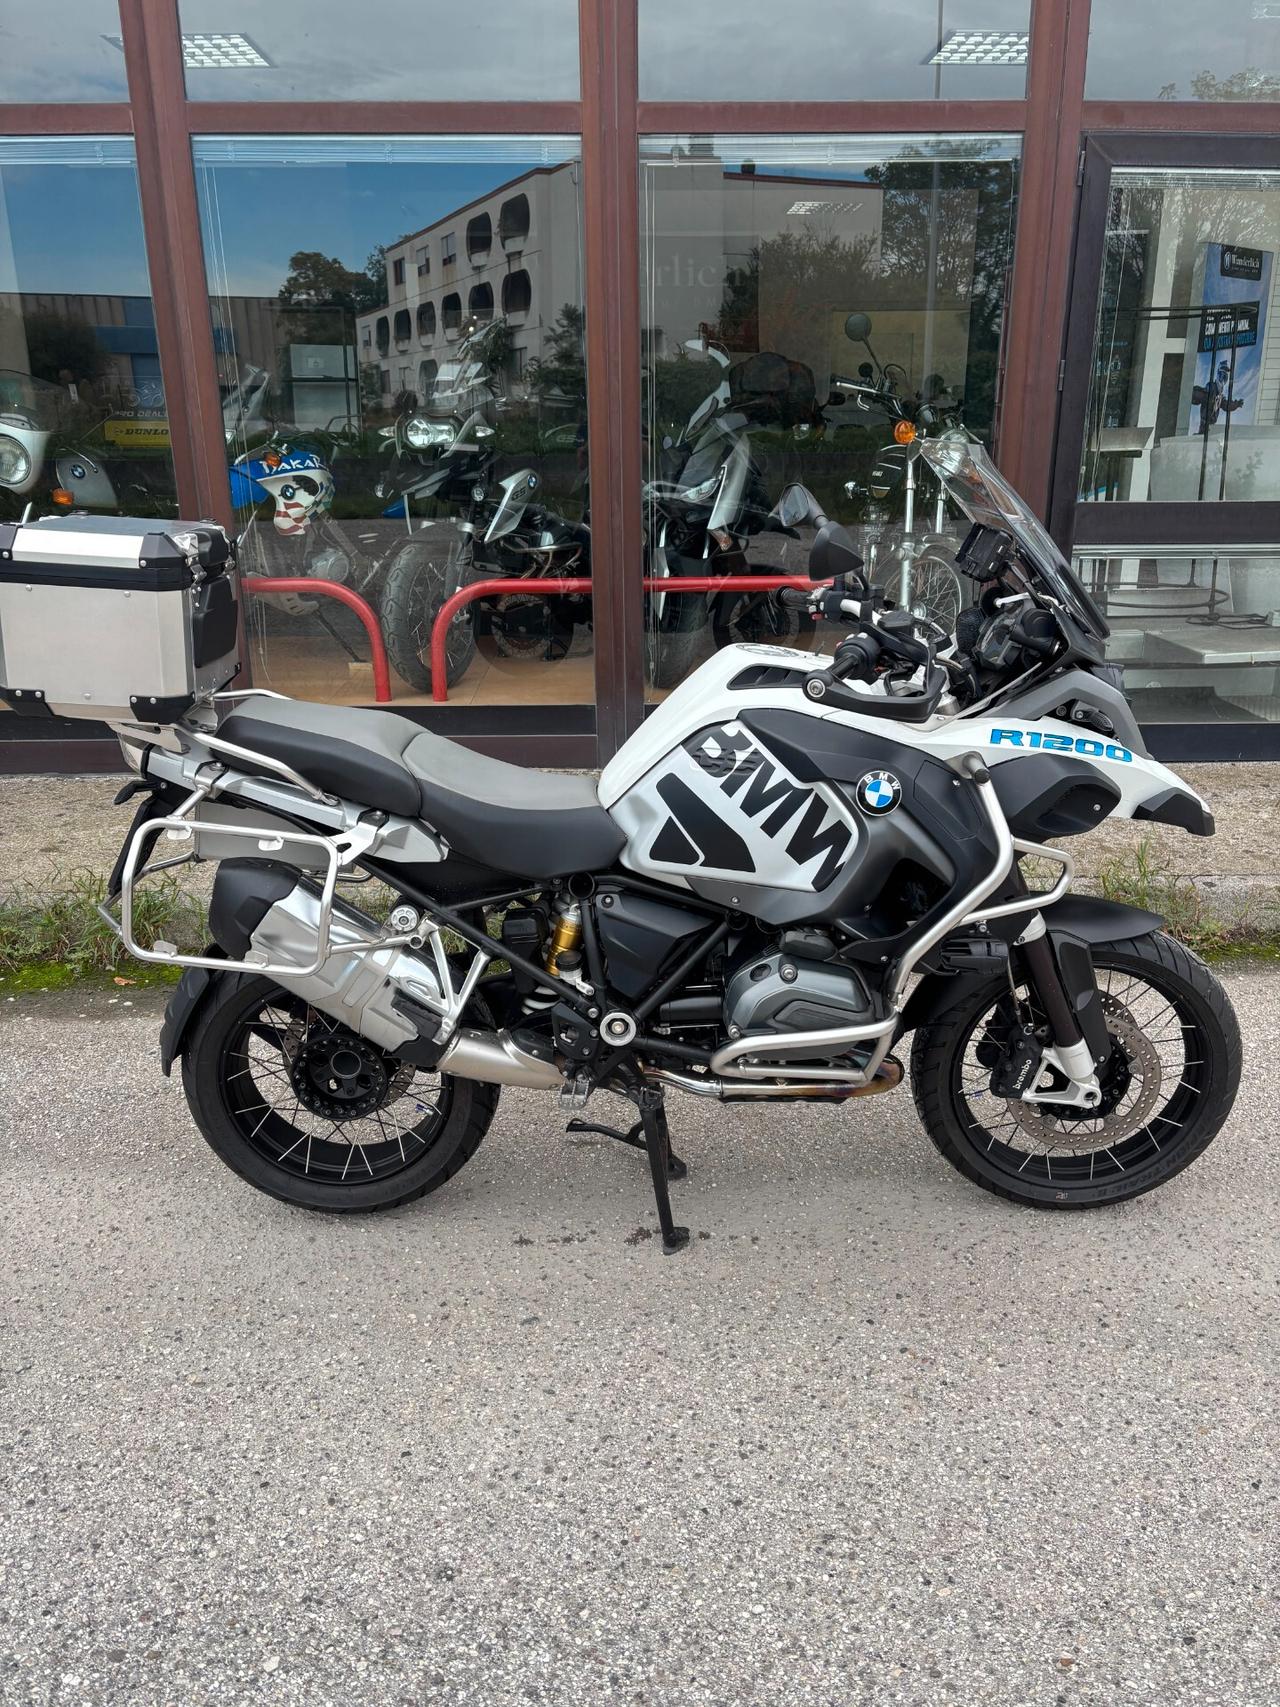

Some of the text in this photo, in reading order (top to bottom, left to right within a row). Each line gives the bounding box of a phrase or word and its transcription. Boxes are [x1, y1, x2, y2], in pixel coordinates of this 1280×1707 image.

[137, 410, 168, 418] DEAL
[511, 486, 527, 501] GS
[989, 728, 1133, 763] R1200
[863, 772, 901, 790] BMW
[680, 720, 851, 893] BMW
[1012, 1059, 1032, 1090] brembo
